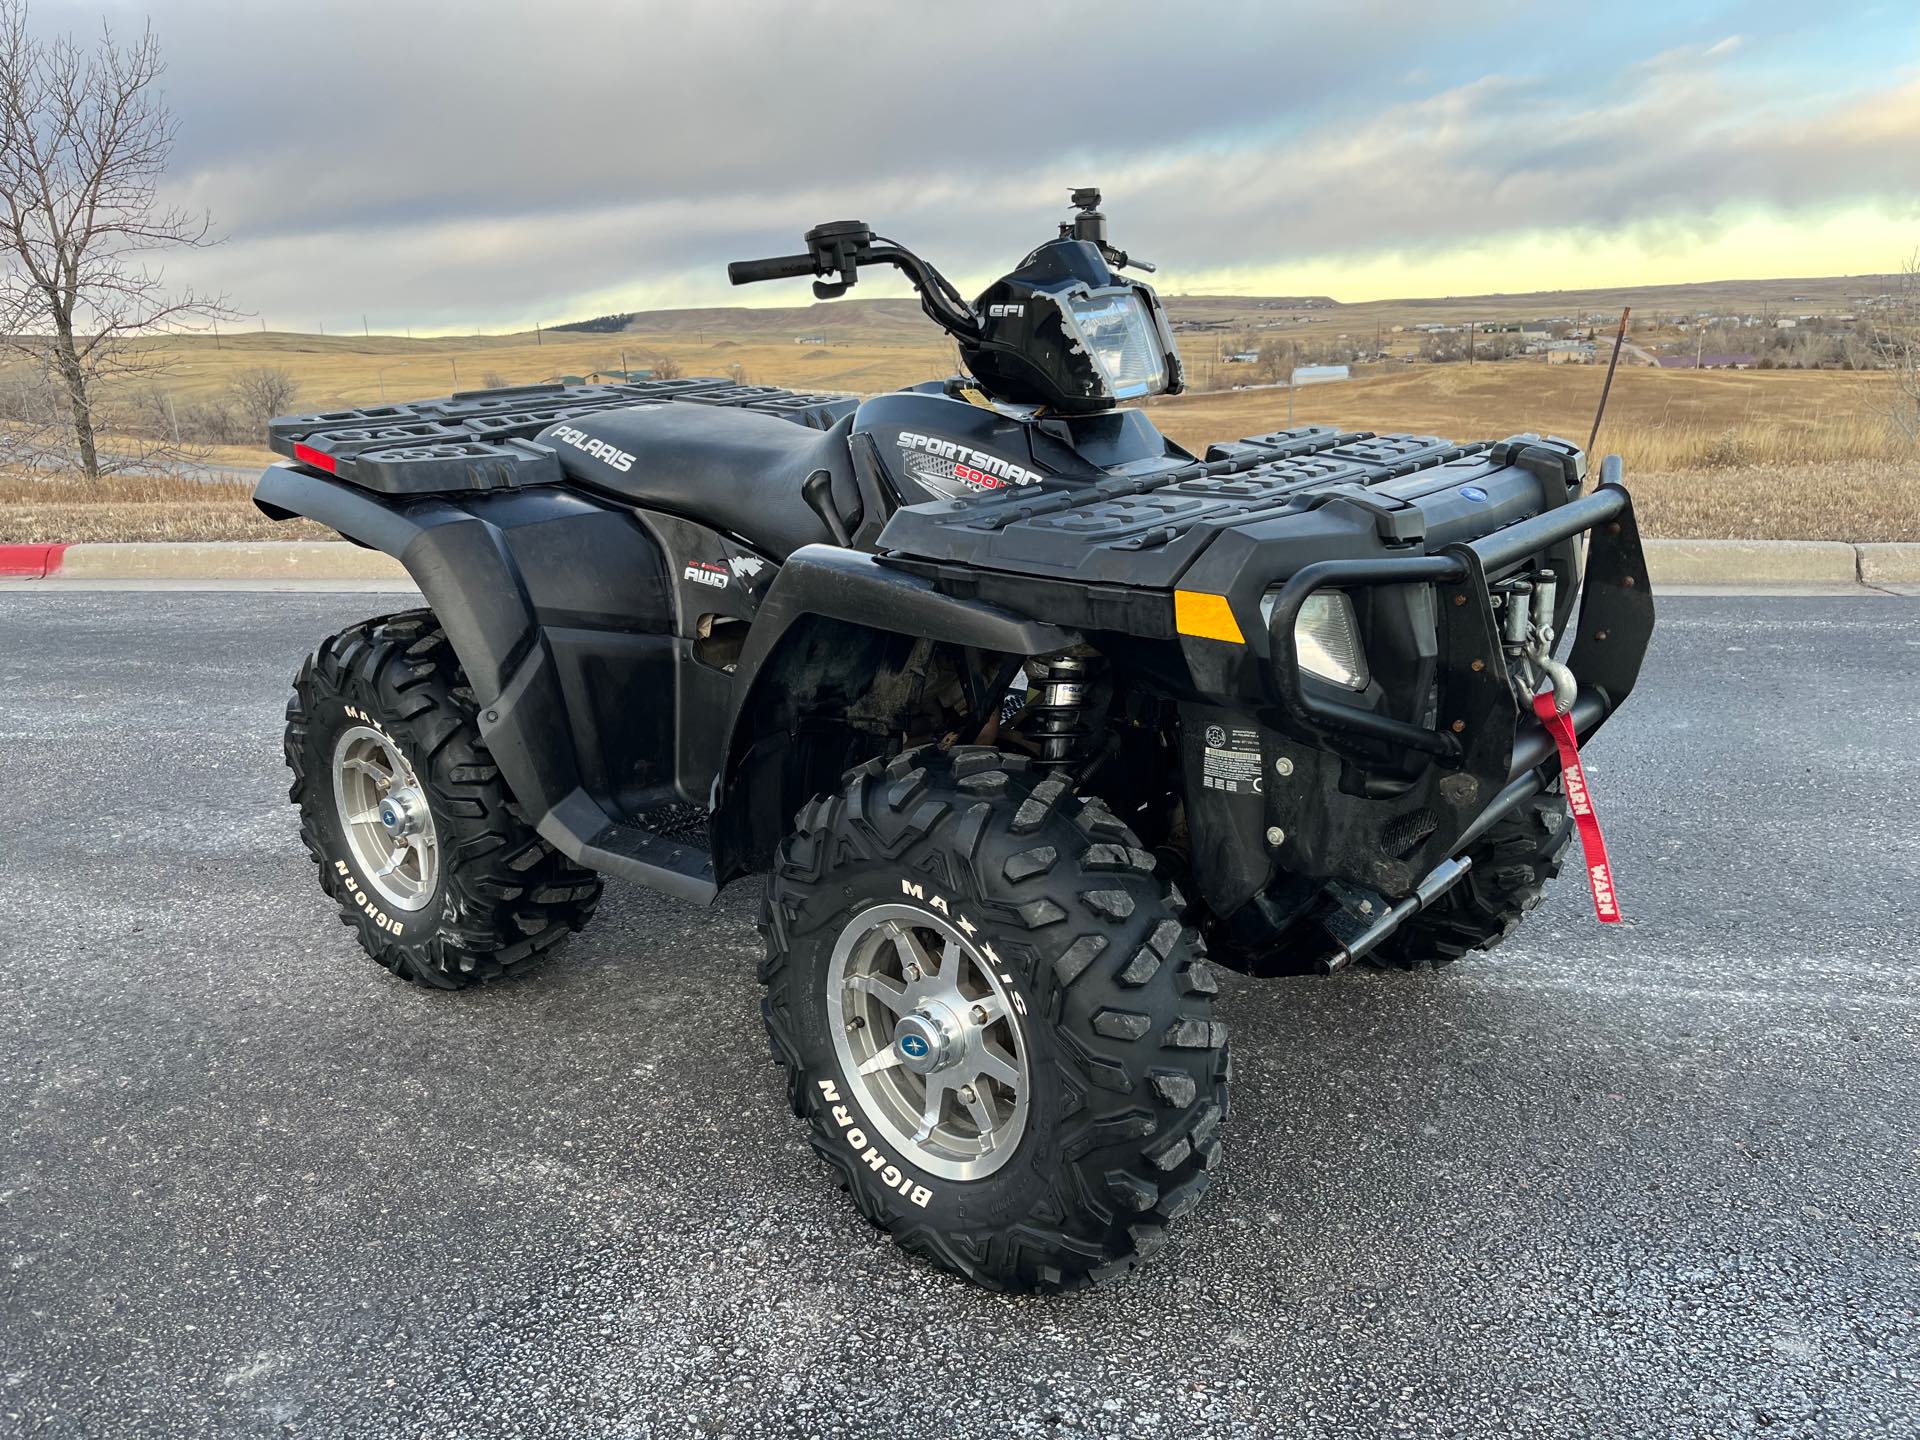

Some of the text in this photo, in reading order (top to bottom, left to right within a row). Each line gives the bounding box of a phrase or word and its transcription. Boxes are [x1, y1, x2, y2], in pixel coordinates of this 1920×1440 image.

[989, 304, 1025, 318] EFI
[550, 425, 637, 472] POLARIS
[896, 431, 1043, 485] SPORTSMAN
[953, 463, 998, 490] 500
[684, 566, 729, 589] AWD
[1564, 764, 1591, 815] WARN
[334, 860, 404, 936] BIGHORN
[1590, 863, 1616, 915] WARN
[901, 879, 1028, 1016] MAXXIS
[818, 1079, 933, 1209] BIGHORN
